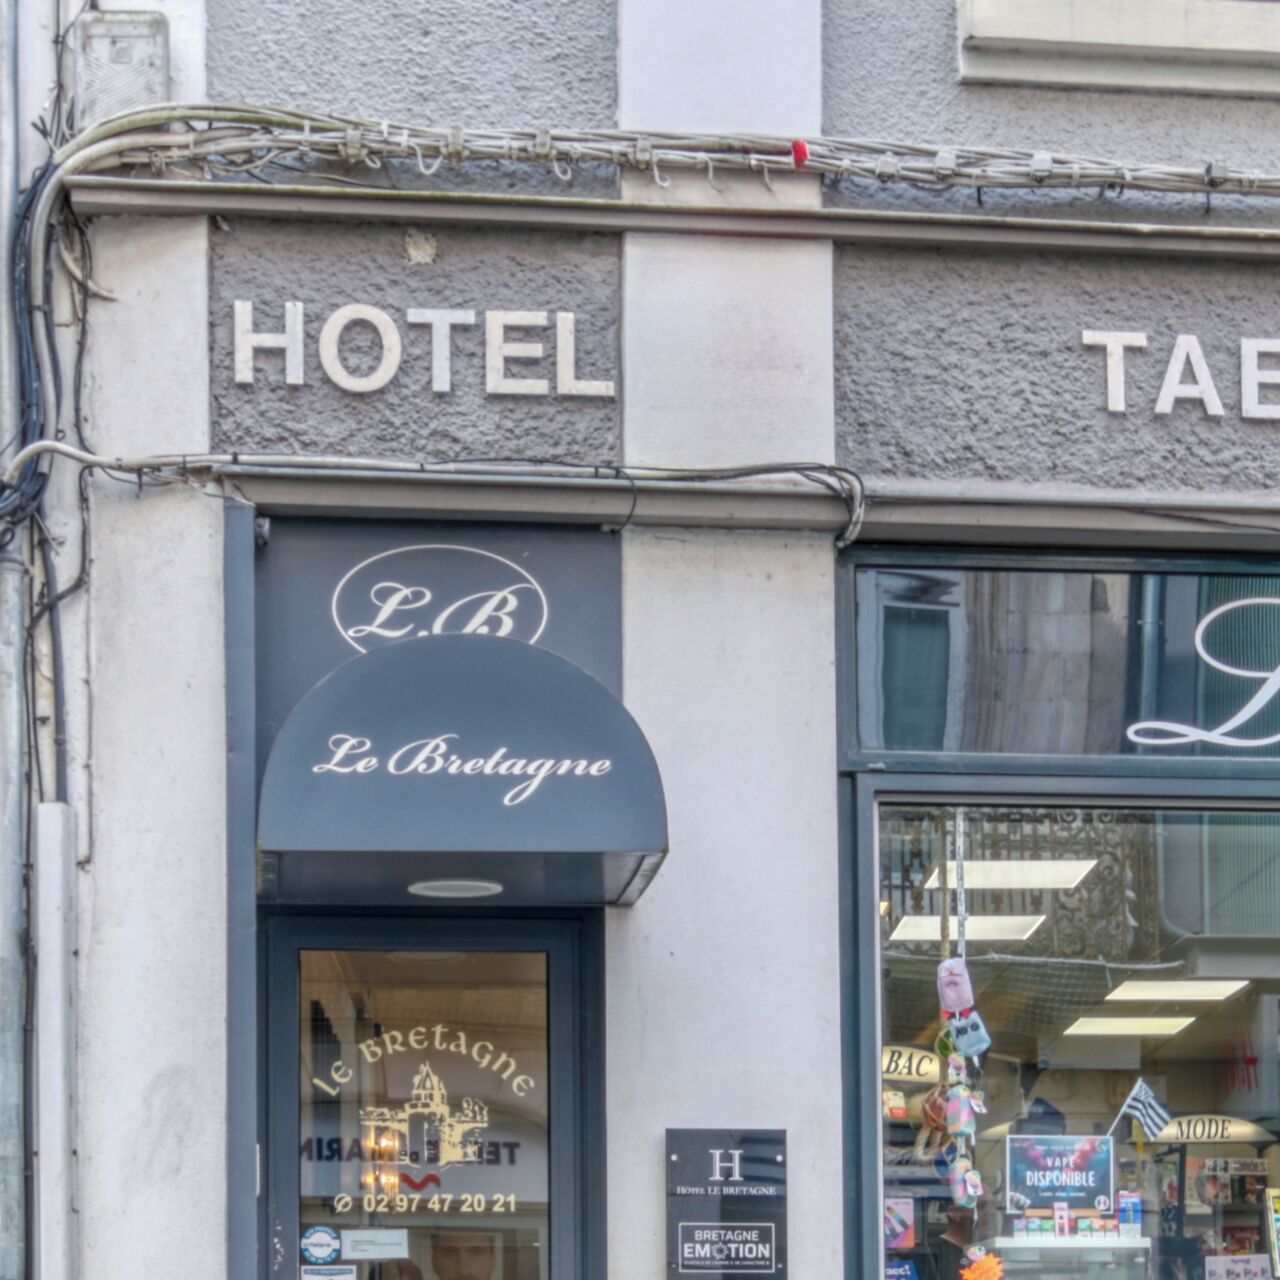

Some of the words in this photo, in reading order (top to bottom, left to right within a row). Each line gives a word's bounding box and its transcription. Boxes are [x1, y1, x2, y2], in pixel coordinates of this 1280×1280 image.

[234, 301, 615, 398] HOTEL
[312, 734, 379, 774] Le
[387, 734, 613, 807] Bretagne
[1175, 1117, 1232, 1140] MODE
[708, 1149, 744, 1181] H
[1046, 1156, 1075, 1168] VAPE
[1026, 1171, 1096, 1186] DISPONIBLE
[708, 1186, 720, 1195] LE
[722, 1186, 777, 1195] BRETAGNE
[363, 1194, 388, 1212] 02
[395, 1194, 421, 1212] 97
[428, 1194, 453, 1212] 47
[460, 1194, 486, 1212] 20
[492, 1194, 517, 1212] 21
[694, 1230, 759, 1241] BRETAGNE
[683, 1242, 770, 1259] EMOTION
